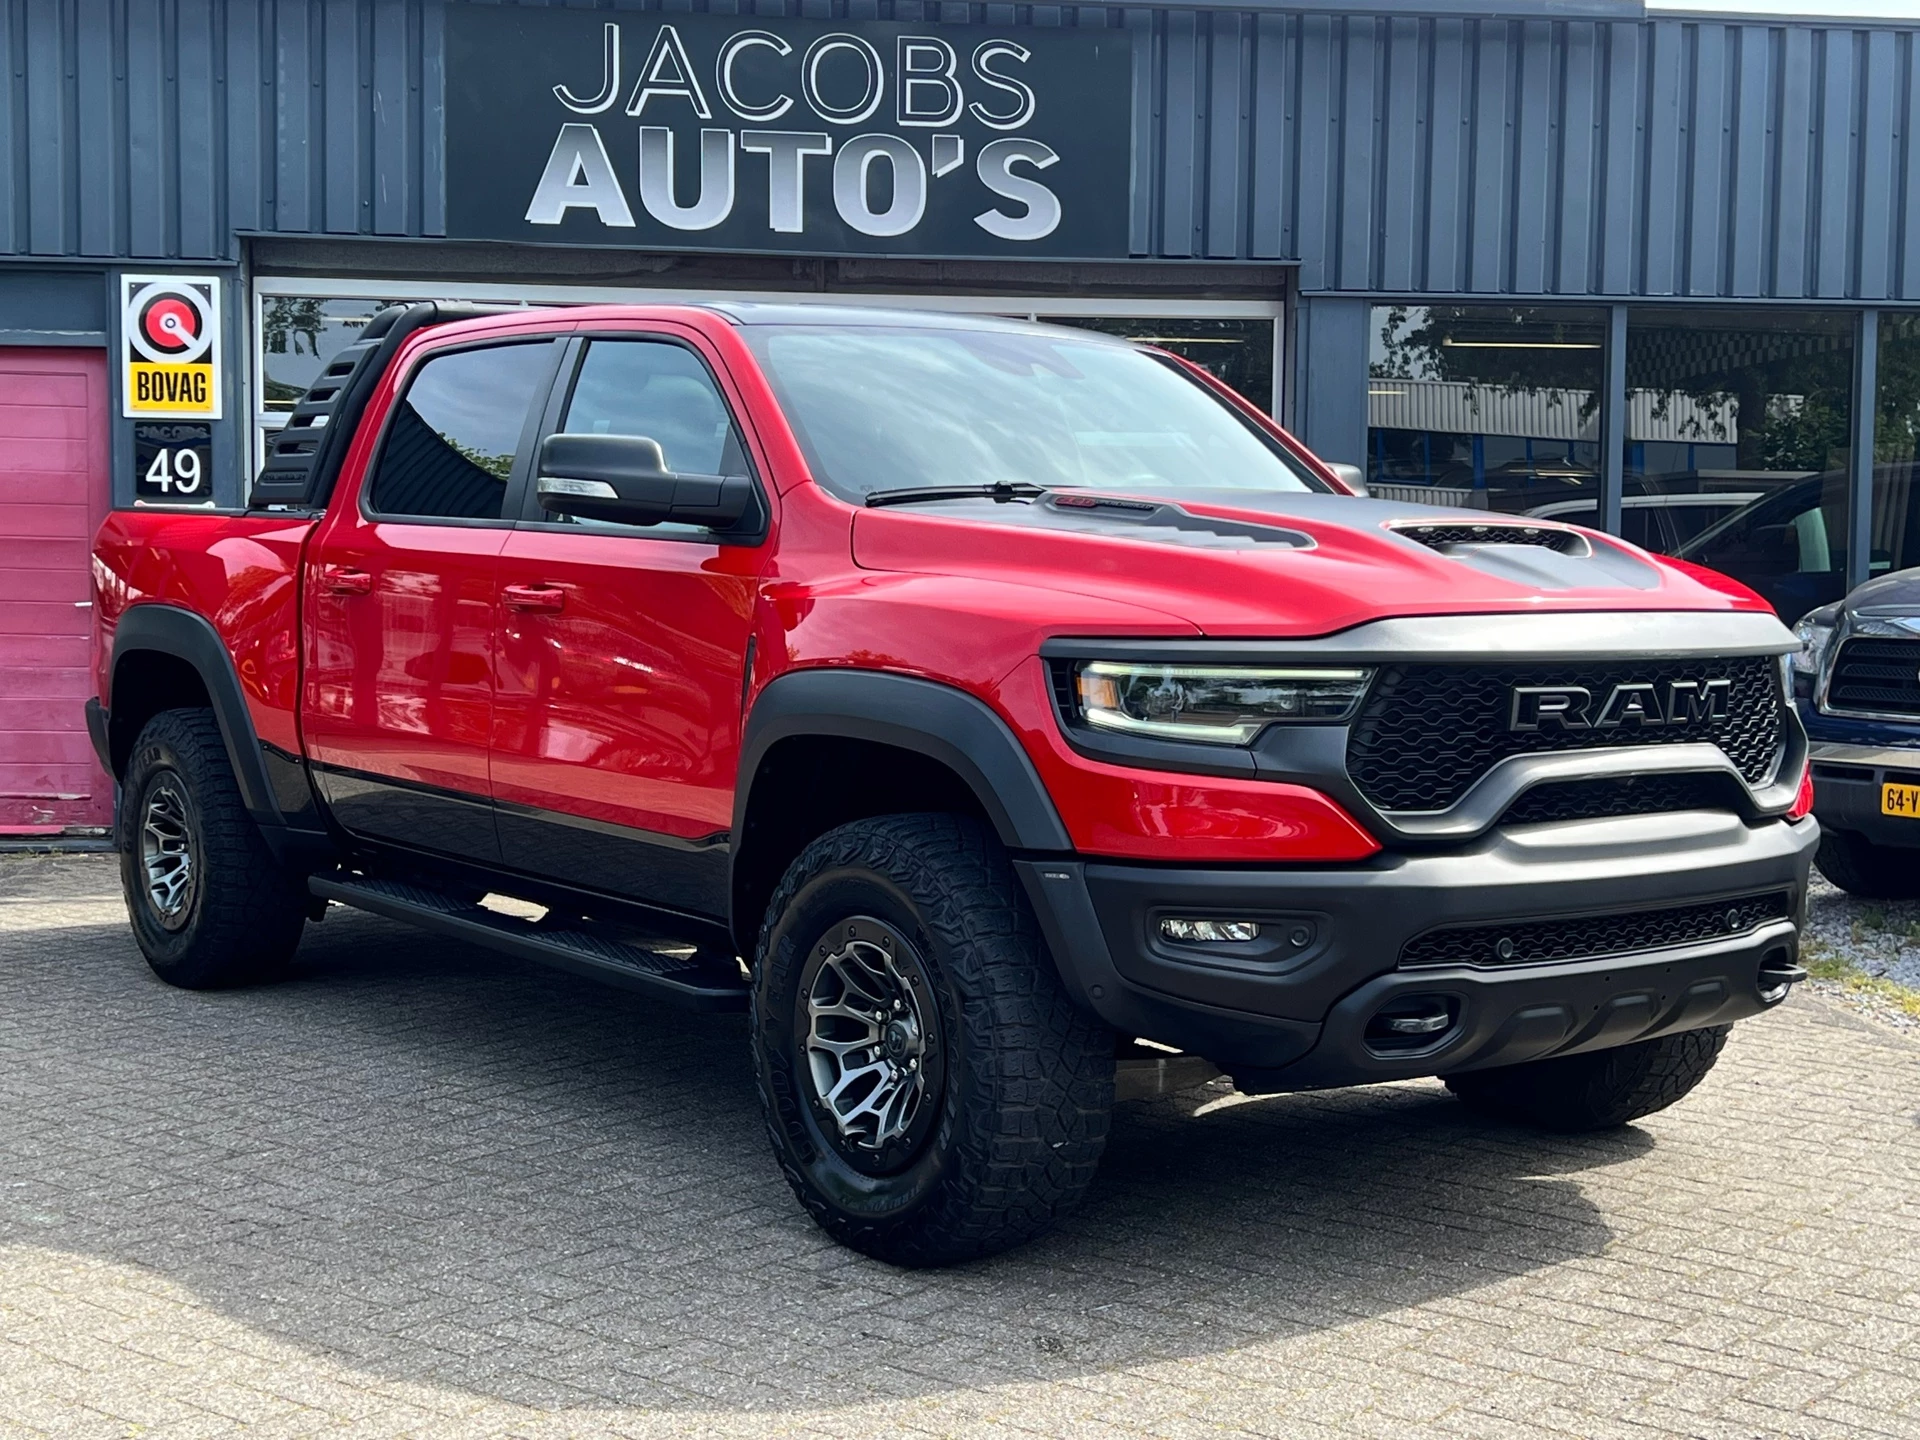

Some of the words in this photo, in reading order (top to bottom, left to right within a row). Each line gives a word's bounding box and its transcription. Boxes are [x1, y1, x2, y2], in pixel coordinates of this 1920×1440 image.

[552, 23, 1036, 130] JACOBS
[525, 123, 1062, 241] AUTO'S
[137, 371, 207, 402] BOVAG
[145, 448, 201, 493] 49
[1510, 679, 1731, 731] RAM
[1887, 788, 1919, 813] 64-V
